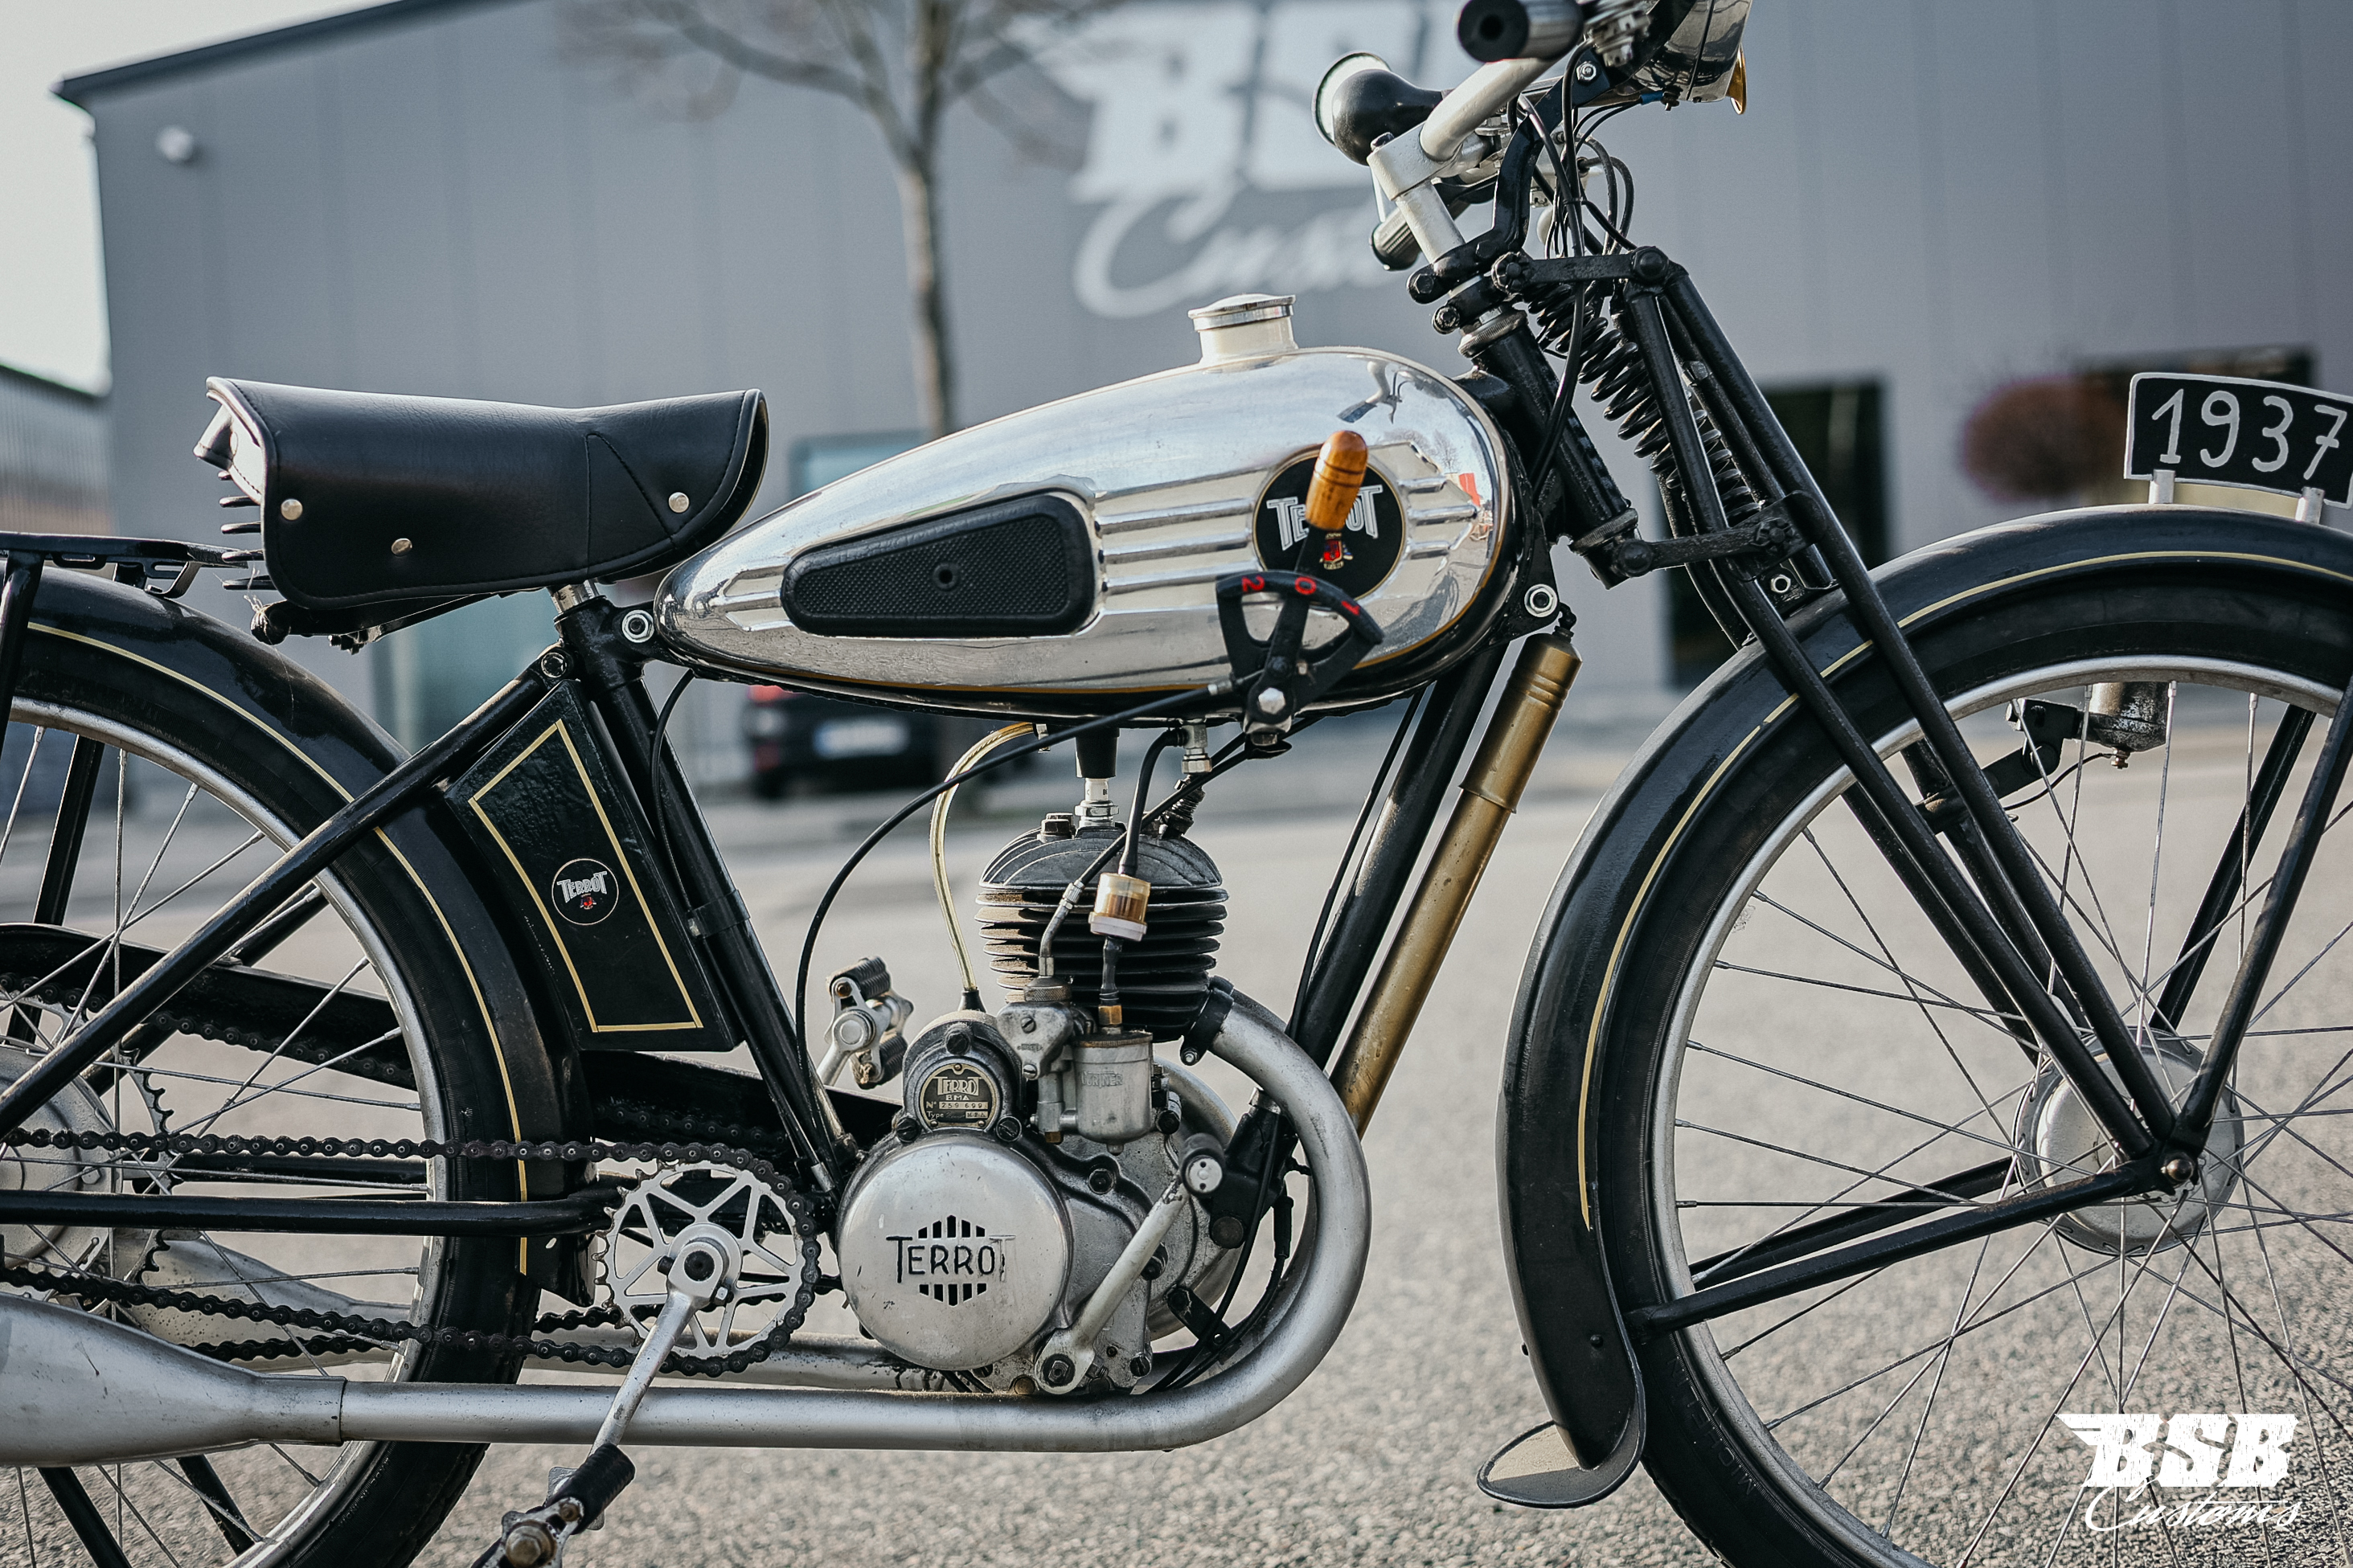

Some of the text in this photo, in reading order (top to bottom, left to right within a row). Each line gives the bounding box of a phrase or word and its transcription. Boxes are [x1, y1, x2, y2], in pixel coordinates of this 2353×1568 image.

[2151, 388, 2347, 481] 1937
[1266, 485, 1384, 551] TEOT
[556, 870, 608, 903] TERROT
[933, 1076, 985, 1096] TERROT
[926, 1111, 945, 1120] Type
[886, 1234, 1016, 1283] TERROT
[1666, 1356, 1757, 1496] MICHELIN
